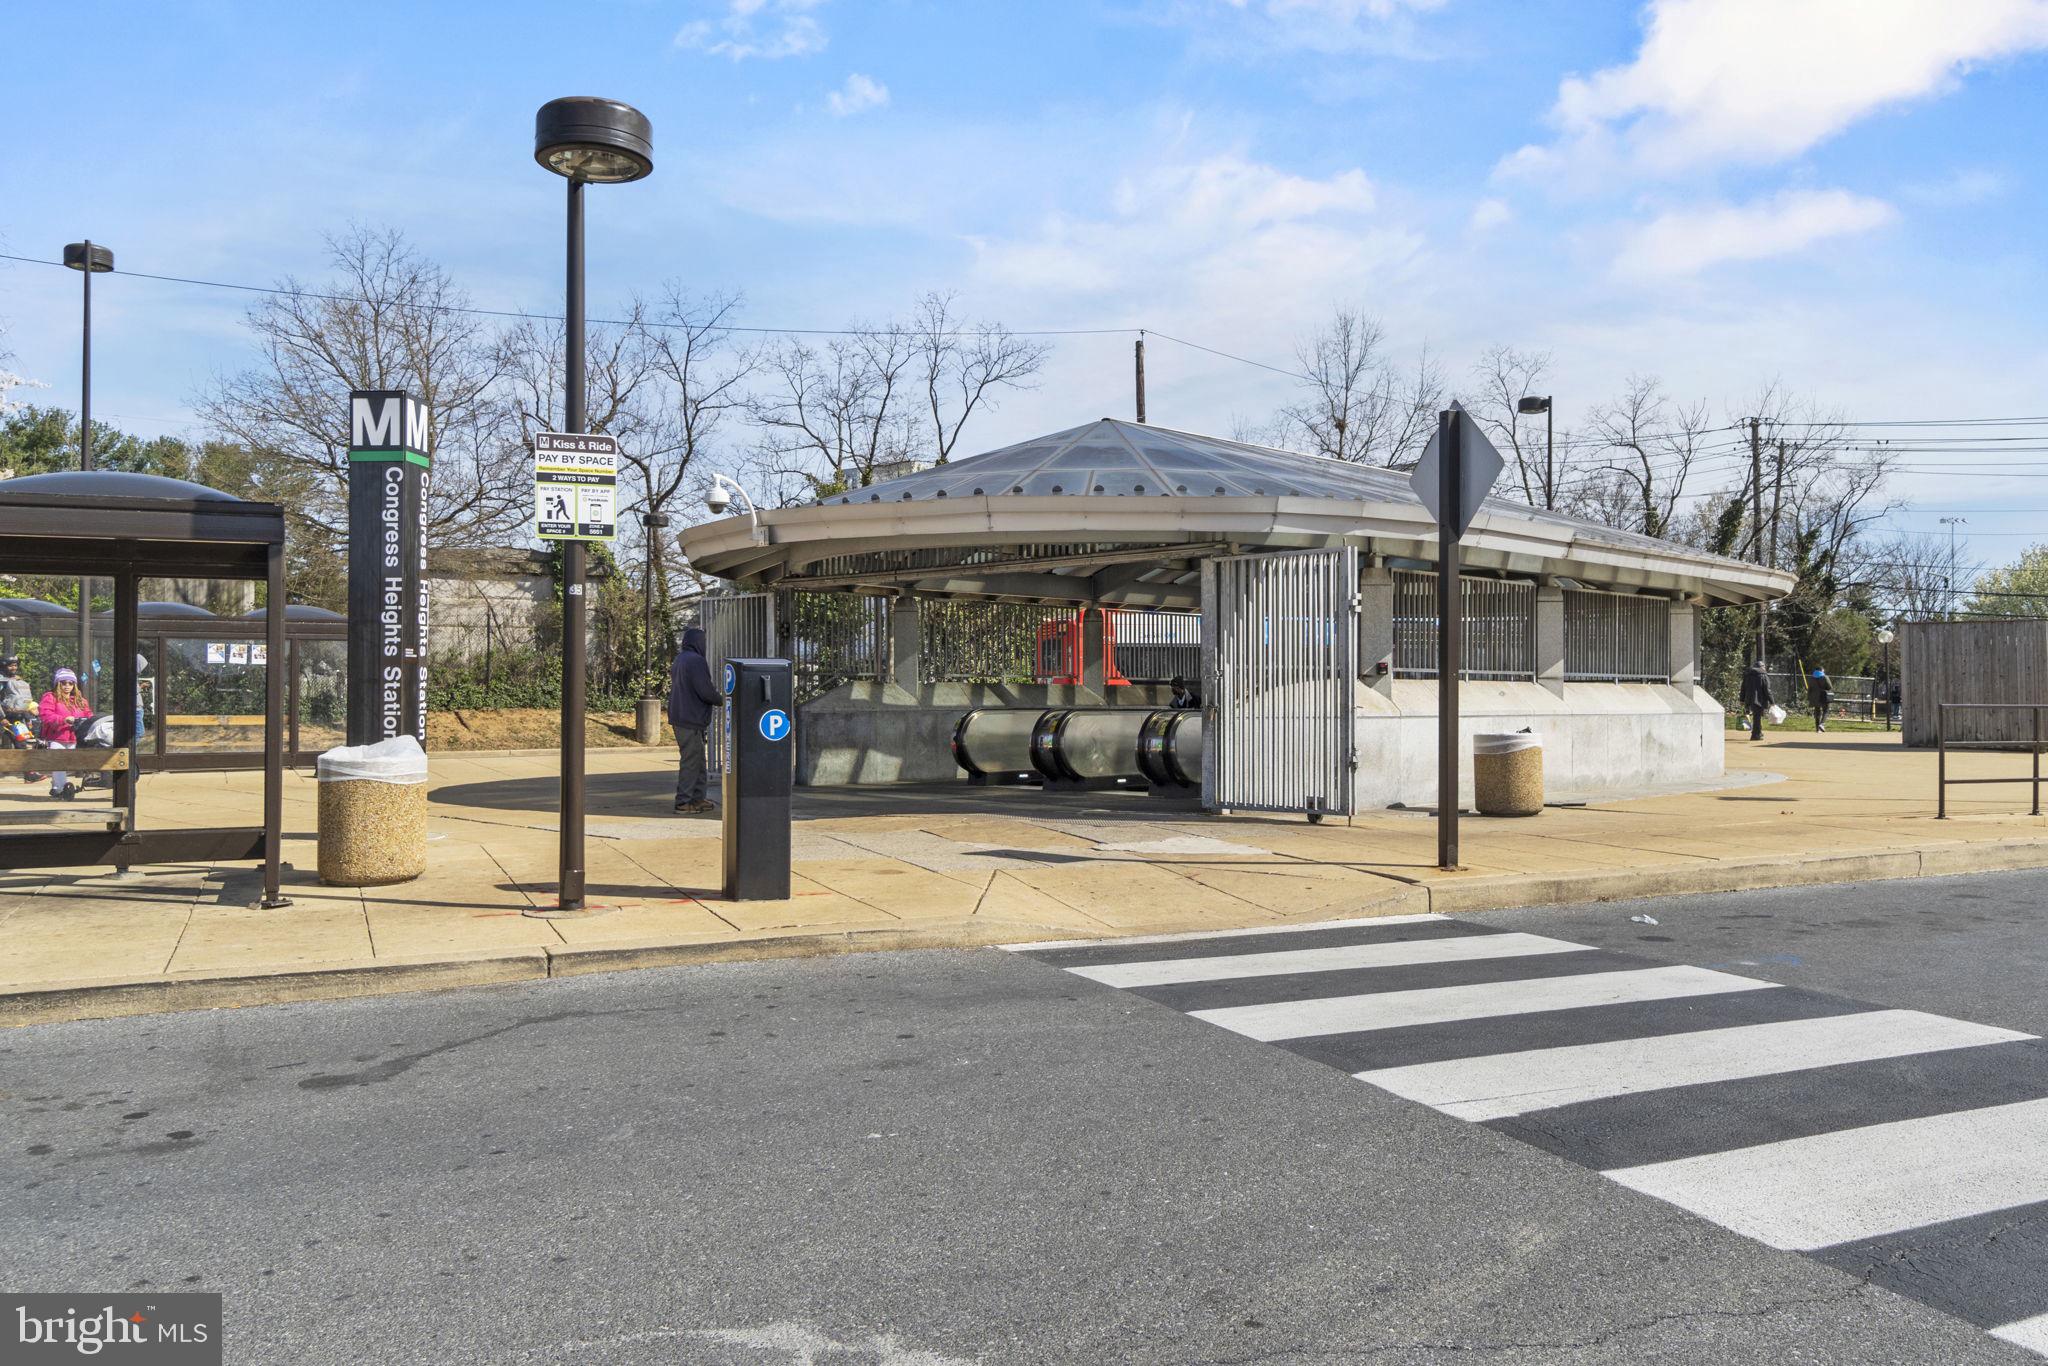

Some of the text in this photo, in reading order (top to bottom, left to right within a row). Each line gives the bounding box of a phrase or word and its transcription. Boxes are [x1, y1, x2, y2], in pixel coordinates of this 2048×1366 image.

[353, 397, 401, 446] M
[406, 398, 428, 452] M
[553, 439, 612, 452] Kiss & Ride
[538, 453, 614, 466] PAY BY SPACE
[380, 466, 403, 741] Congress Heights Station
[417, 472, 429, 741] Congress Heights Station
[769, 715, 783, 736] P
